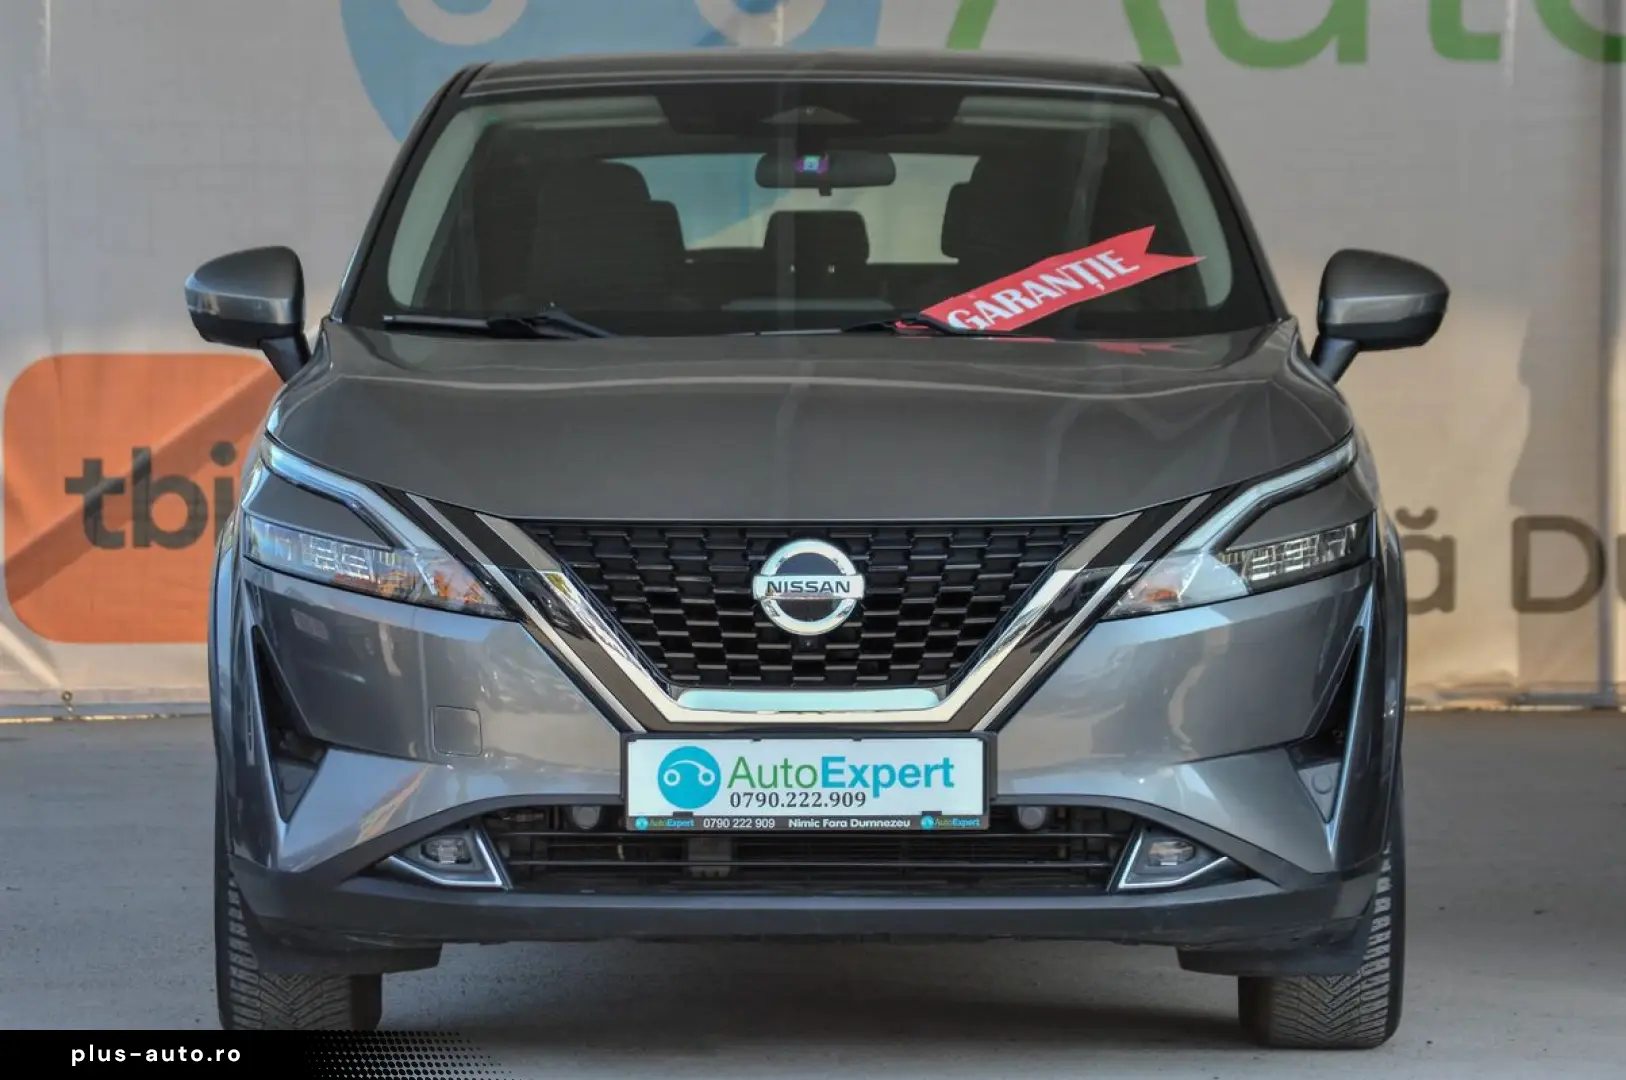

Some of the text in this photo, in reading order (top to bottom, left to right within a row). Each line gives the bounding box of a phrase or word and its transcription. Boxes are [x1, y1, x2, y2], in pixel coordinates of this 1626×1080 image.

[65, 441, 236, 550] tbi
[767, 580, 850, 594] NISSAN
[727, 755, 955, 798] AutoExpert
[729, 791, 867, 808] 0790.222.909
[703, 818, 729, 829] 0790
[733, 818, 751, 829] 222
[755, 818, 775, 829] 909
[788, 818, 820, 829] Nimic
[823, 818, 848, 829] Fara
[850, 818, 911, 829] Dumnezeu
